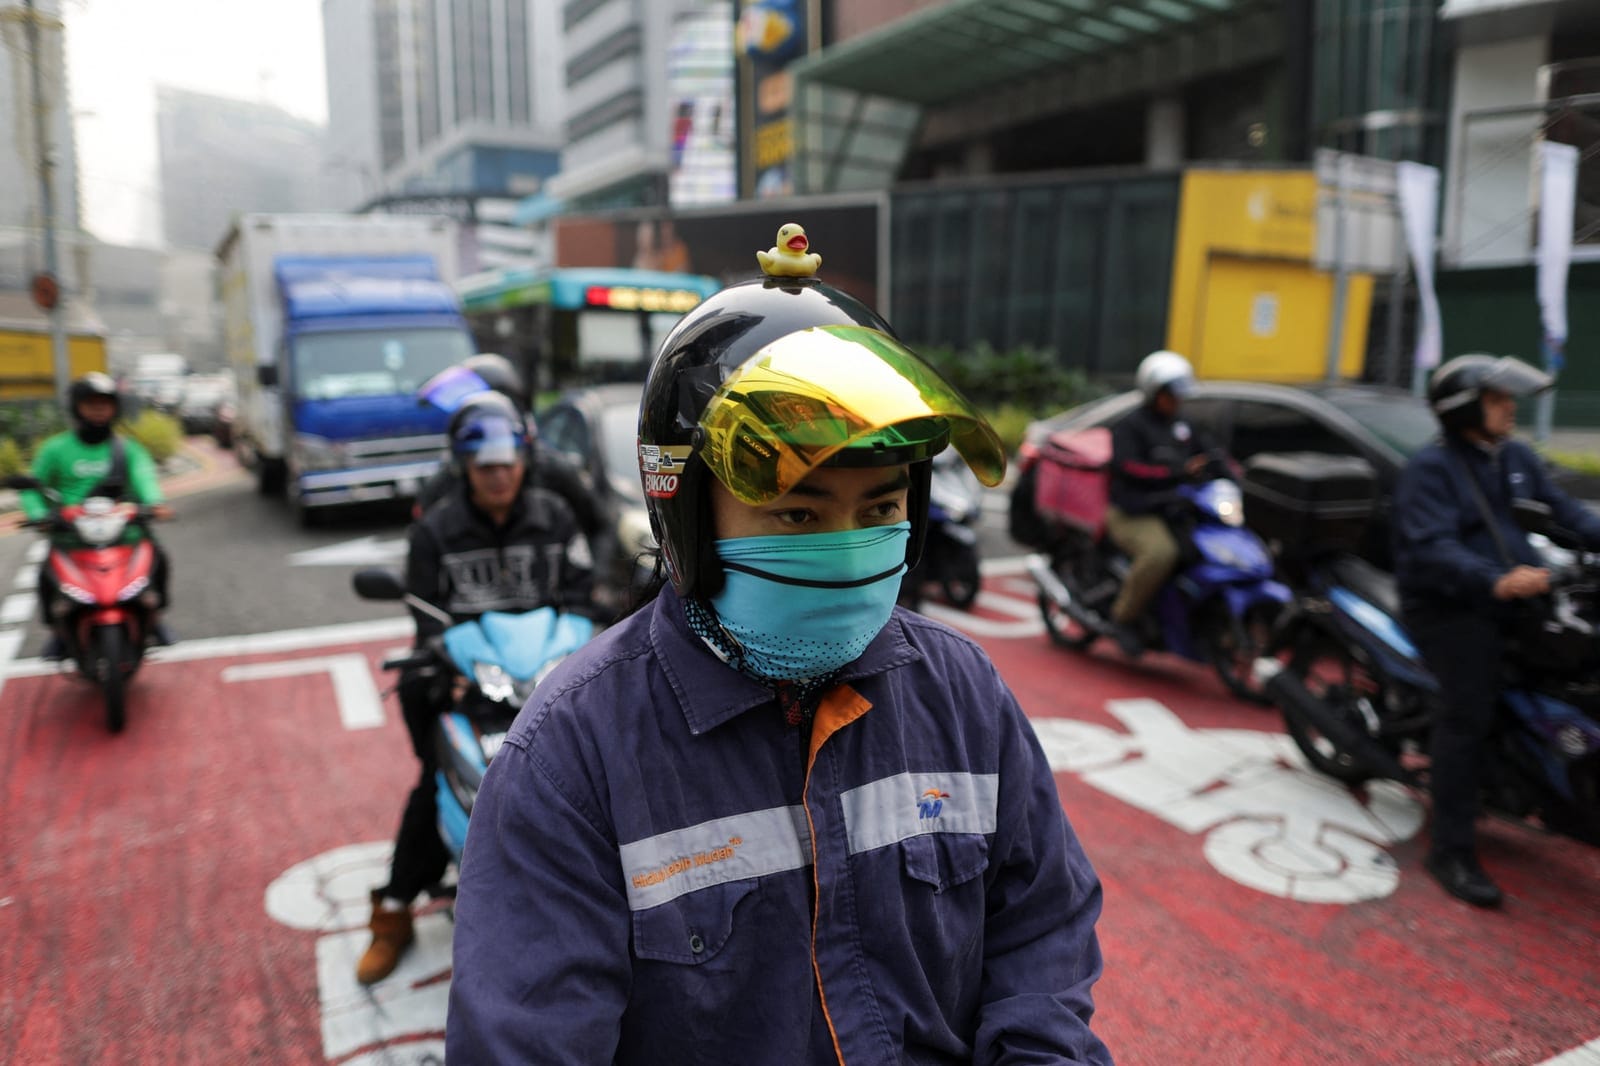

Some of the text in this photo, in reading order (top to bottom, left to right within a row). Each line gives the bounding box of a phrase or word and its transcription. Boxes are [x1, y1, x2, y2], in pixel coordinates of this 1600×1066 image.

[743, 435, 770, 458] MOTO
[645, 474, 678, 493] BIKKO
[665, 857, 692, 877] ebih
